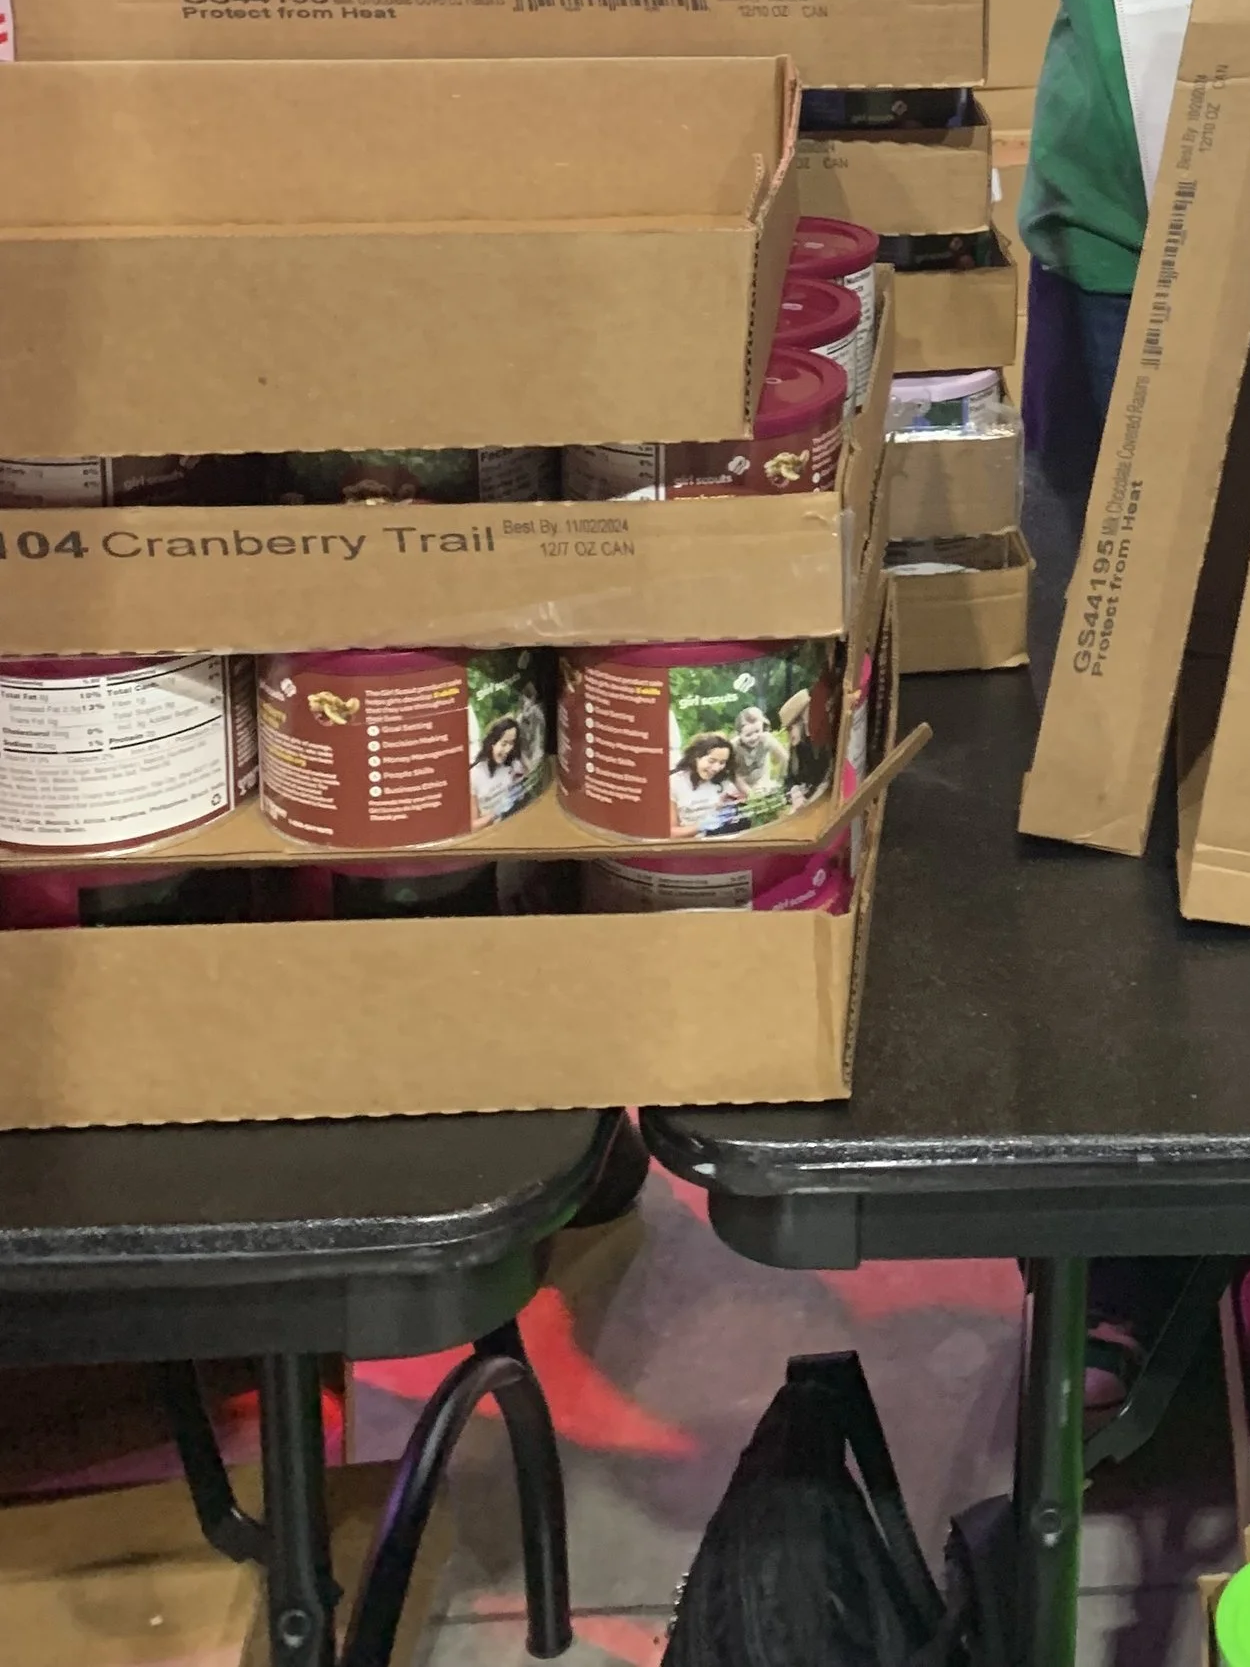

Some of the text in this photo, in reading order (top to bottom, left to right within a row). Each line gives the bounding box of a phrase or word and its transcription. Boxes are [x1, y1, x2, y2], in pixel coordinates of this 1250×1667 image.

[182, 7, 397, 19] Protect from Heat
[802, 7, 829, 18] CAN
[502, 519, 535, 535] Best
[101, 529, 367, 561] Cranberry
[382, 526, 495, 553] Trail
[540, 540, 636, 558] 12/7 OZ CAN
[1072, 539, 1115, 675] GS44195
[1116, 414, 1142, 461] Covered
[1091, 480, 1144, 677] Protect from Heat
[678, 692, 739, 710] girl scouts
